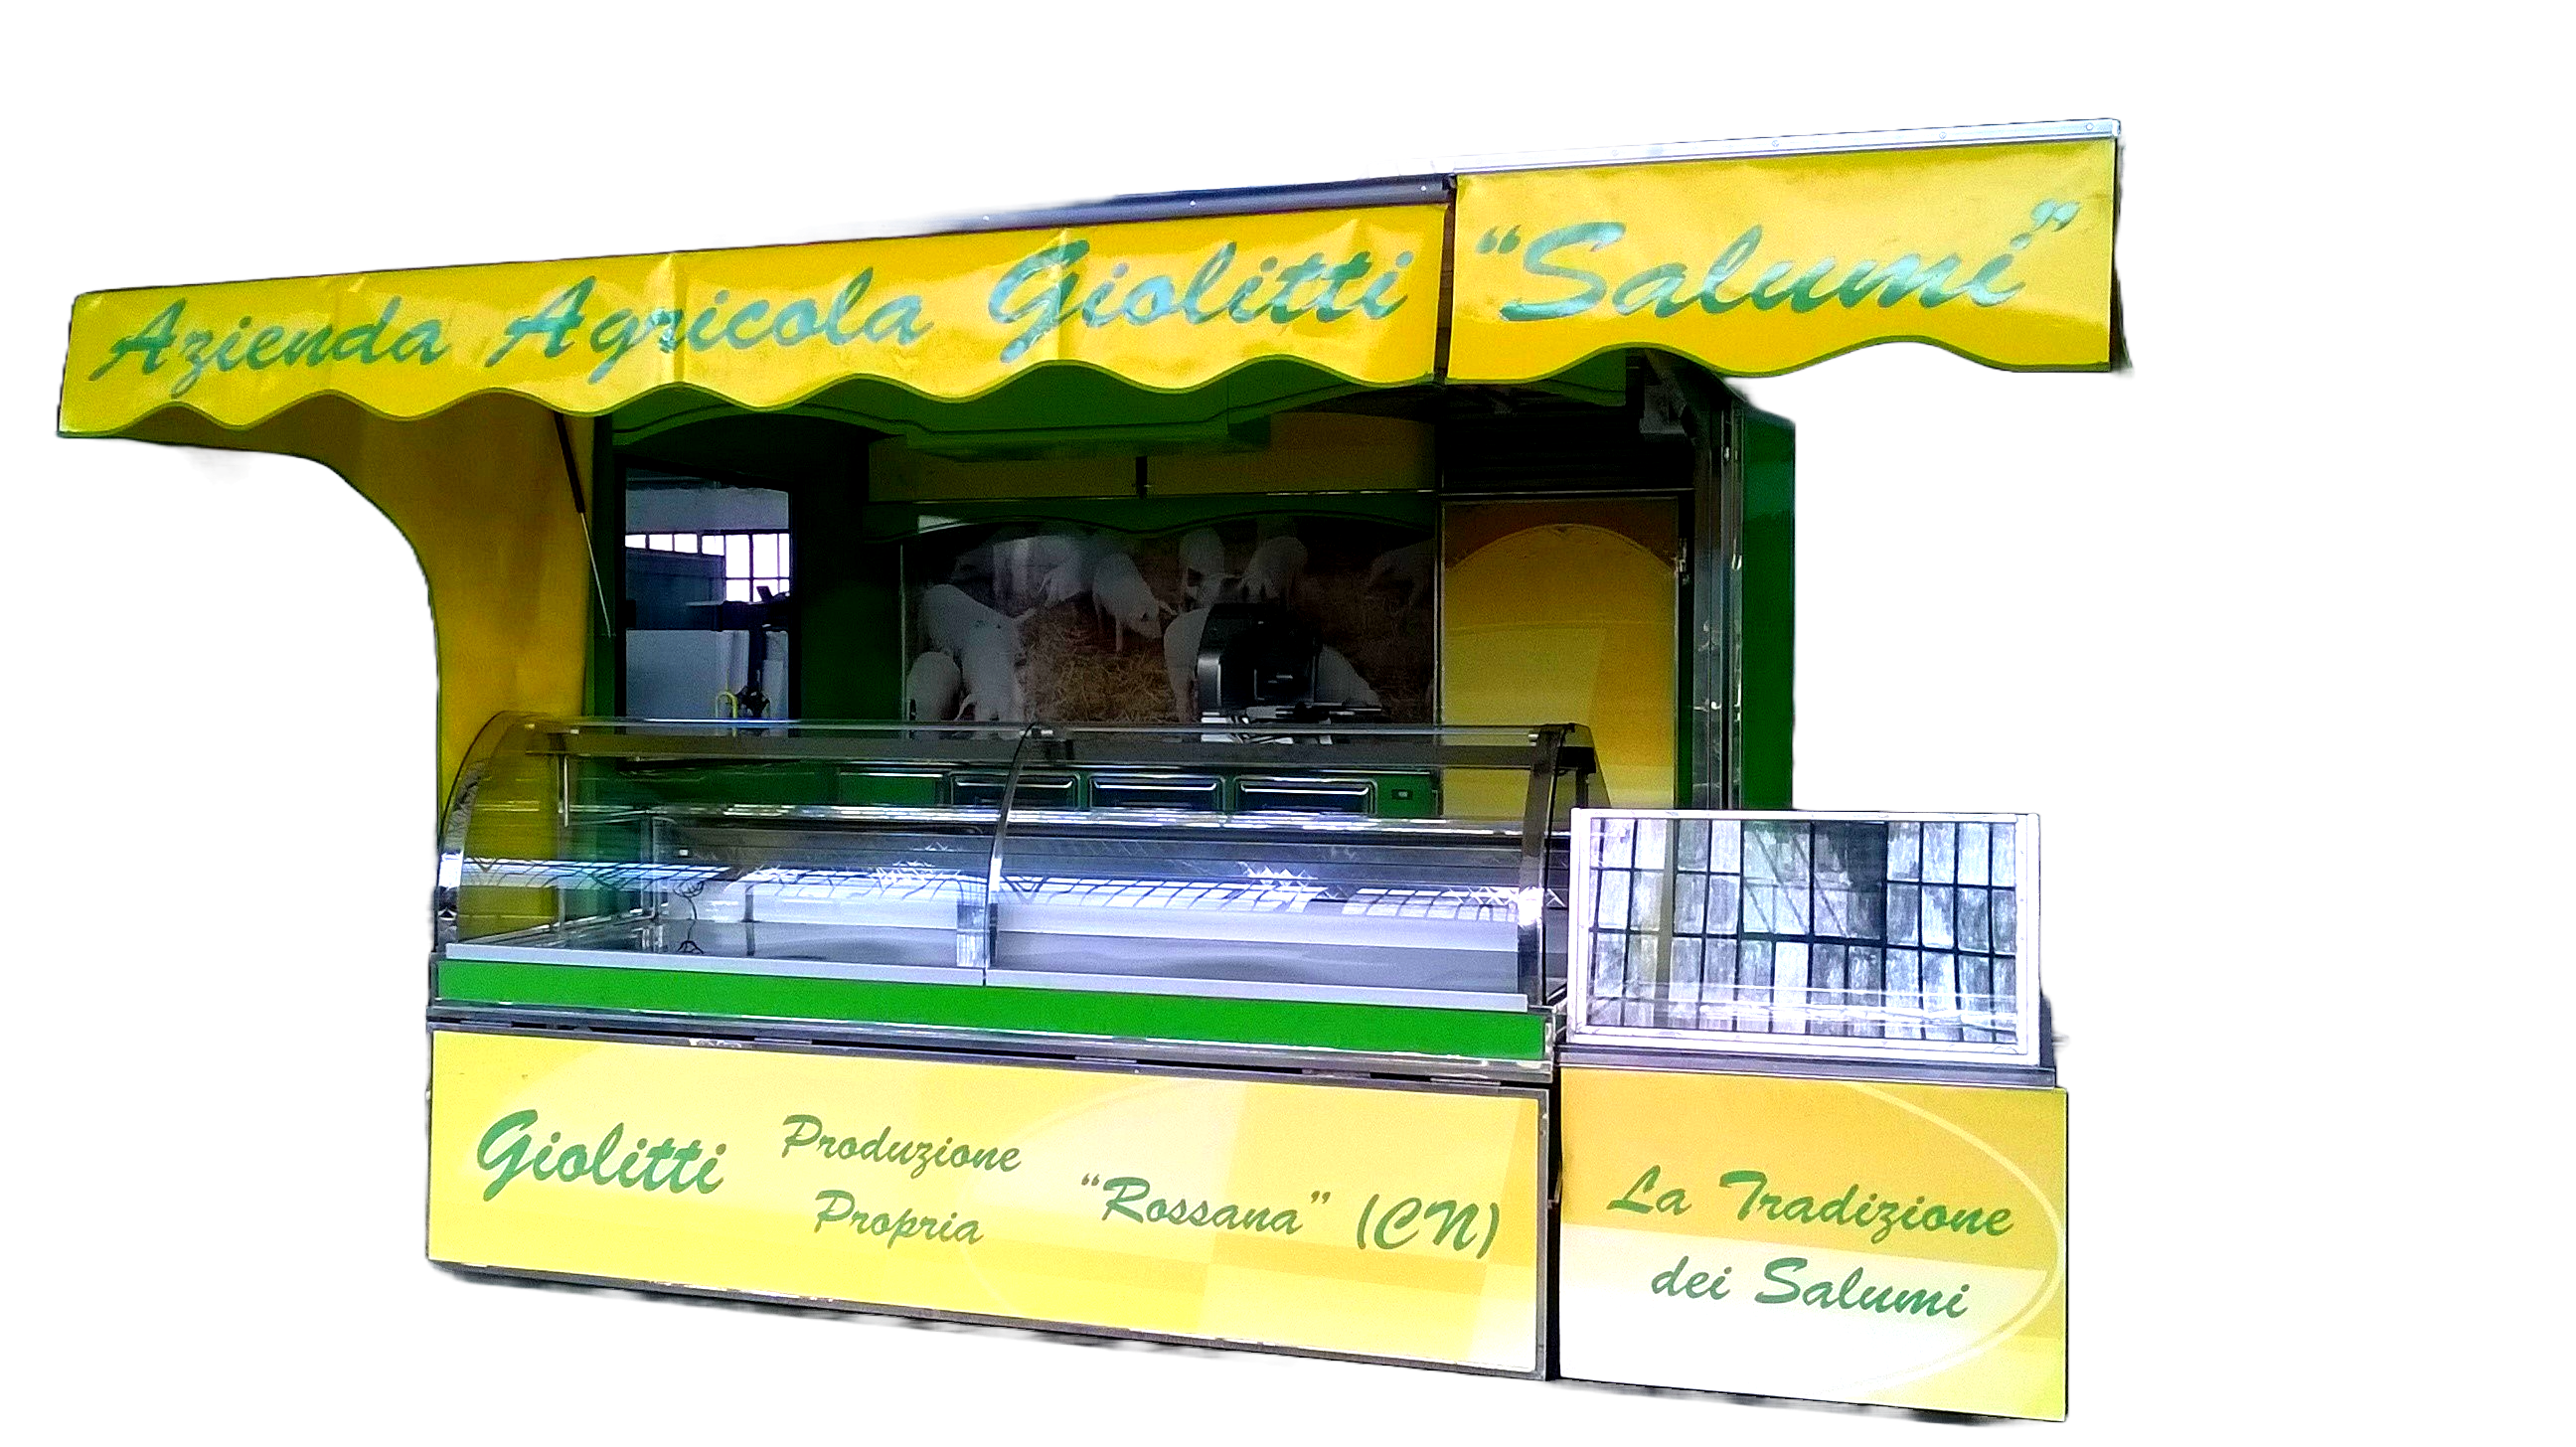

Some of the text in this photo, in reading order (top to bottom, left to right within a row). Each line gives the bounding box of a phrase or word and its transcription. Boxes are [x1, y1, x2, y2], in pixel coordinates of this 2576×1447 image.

[87, 240, 1414, 400] Azienda Agricola Giolitti
[477, 1109, 726, 1202] Giolitti
[781, 1114, 1022, 1179] Produzione
[814, 1190, 984, 1249] Propria
[1357, 1194, 1501, 1259] (CN)
[1606, 1165, 2014, 1244] La Tradizione
[1651, 1256, 1970, 1319] dei Salumi
